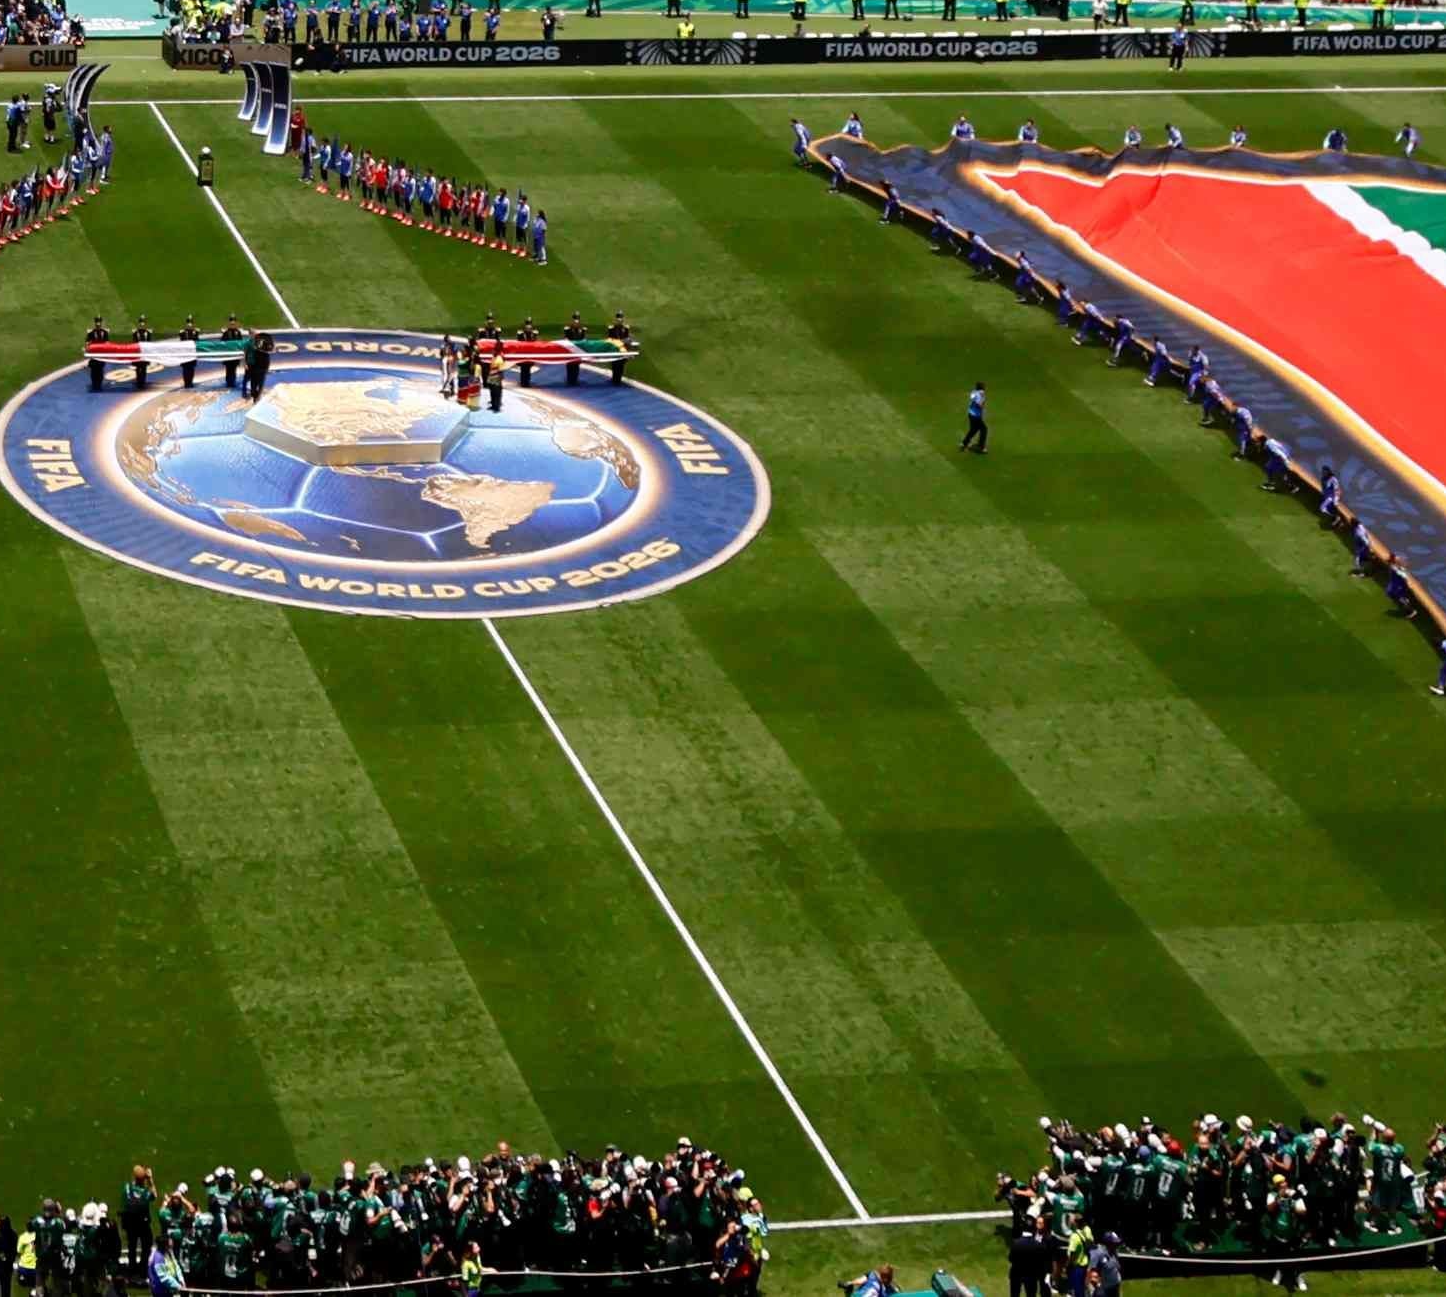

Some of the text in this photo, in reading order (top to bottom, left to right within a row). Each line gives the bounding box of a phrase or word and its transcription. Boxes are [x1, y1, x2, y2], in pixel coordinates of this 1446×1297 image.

[344, 46, 561, 62] FIFA WORLD CUP 2026
[827, 41, 1038, 58] FIFA WORLD CUP 2026
[1293, 36, 1332, 50] FIFA
[1334, 36, 1398, 50] WORLD
[1400, 35, 1435, 49] CUP
[25, 438, 87, 494] FIFA
[654, 422, 730, 475] FIFA
[190, 537, 681, 599] FIFA WORLD CUP 2026
